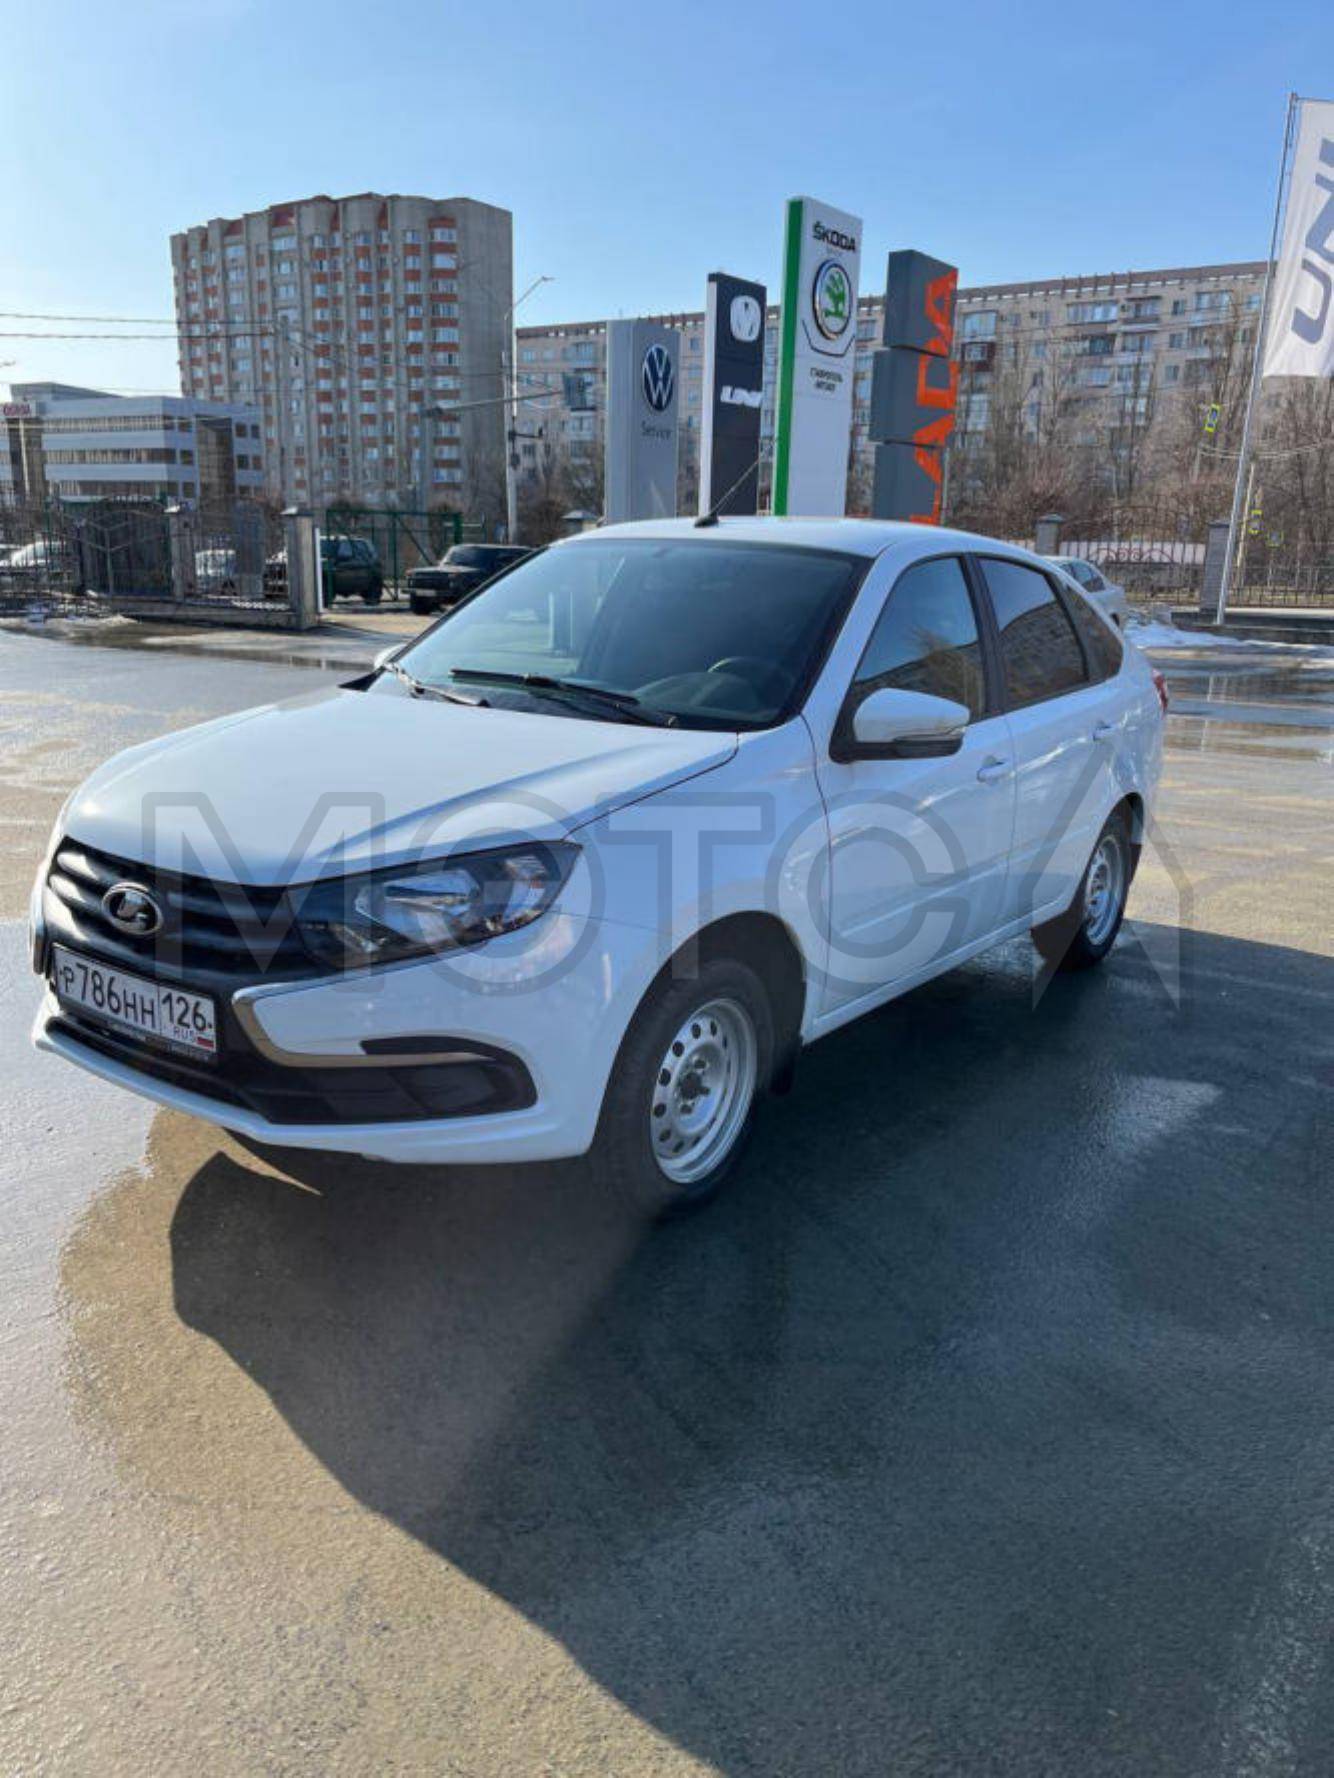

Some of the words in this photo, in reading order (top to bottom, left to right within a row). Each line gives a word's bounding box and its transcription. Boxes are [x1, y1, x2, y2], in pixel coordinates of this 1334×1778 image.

[812, 221, 856, 253] ŠKODA
[909, 269, 959, 525] LADA
[162, 992, 206, 1032] 126
[173, 1026, 196, 1042] RUS
